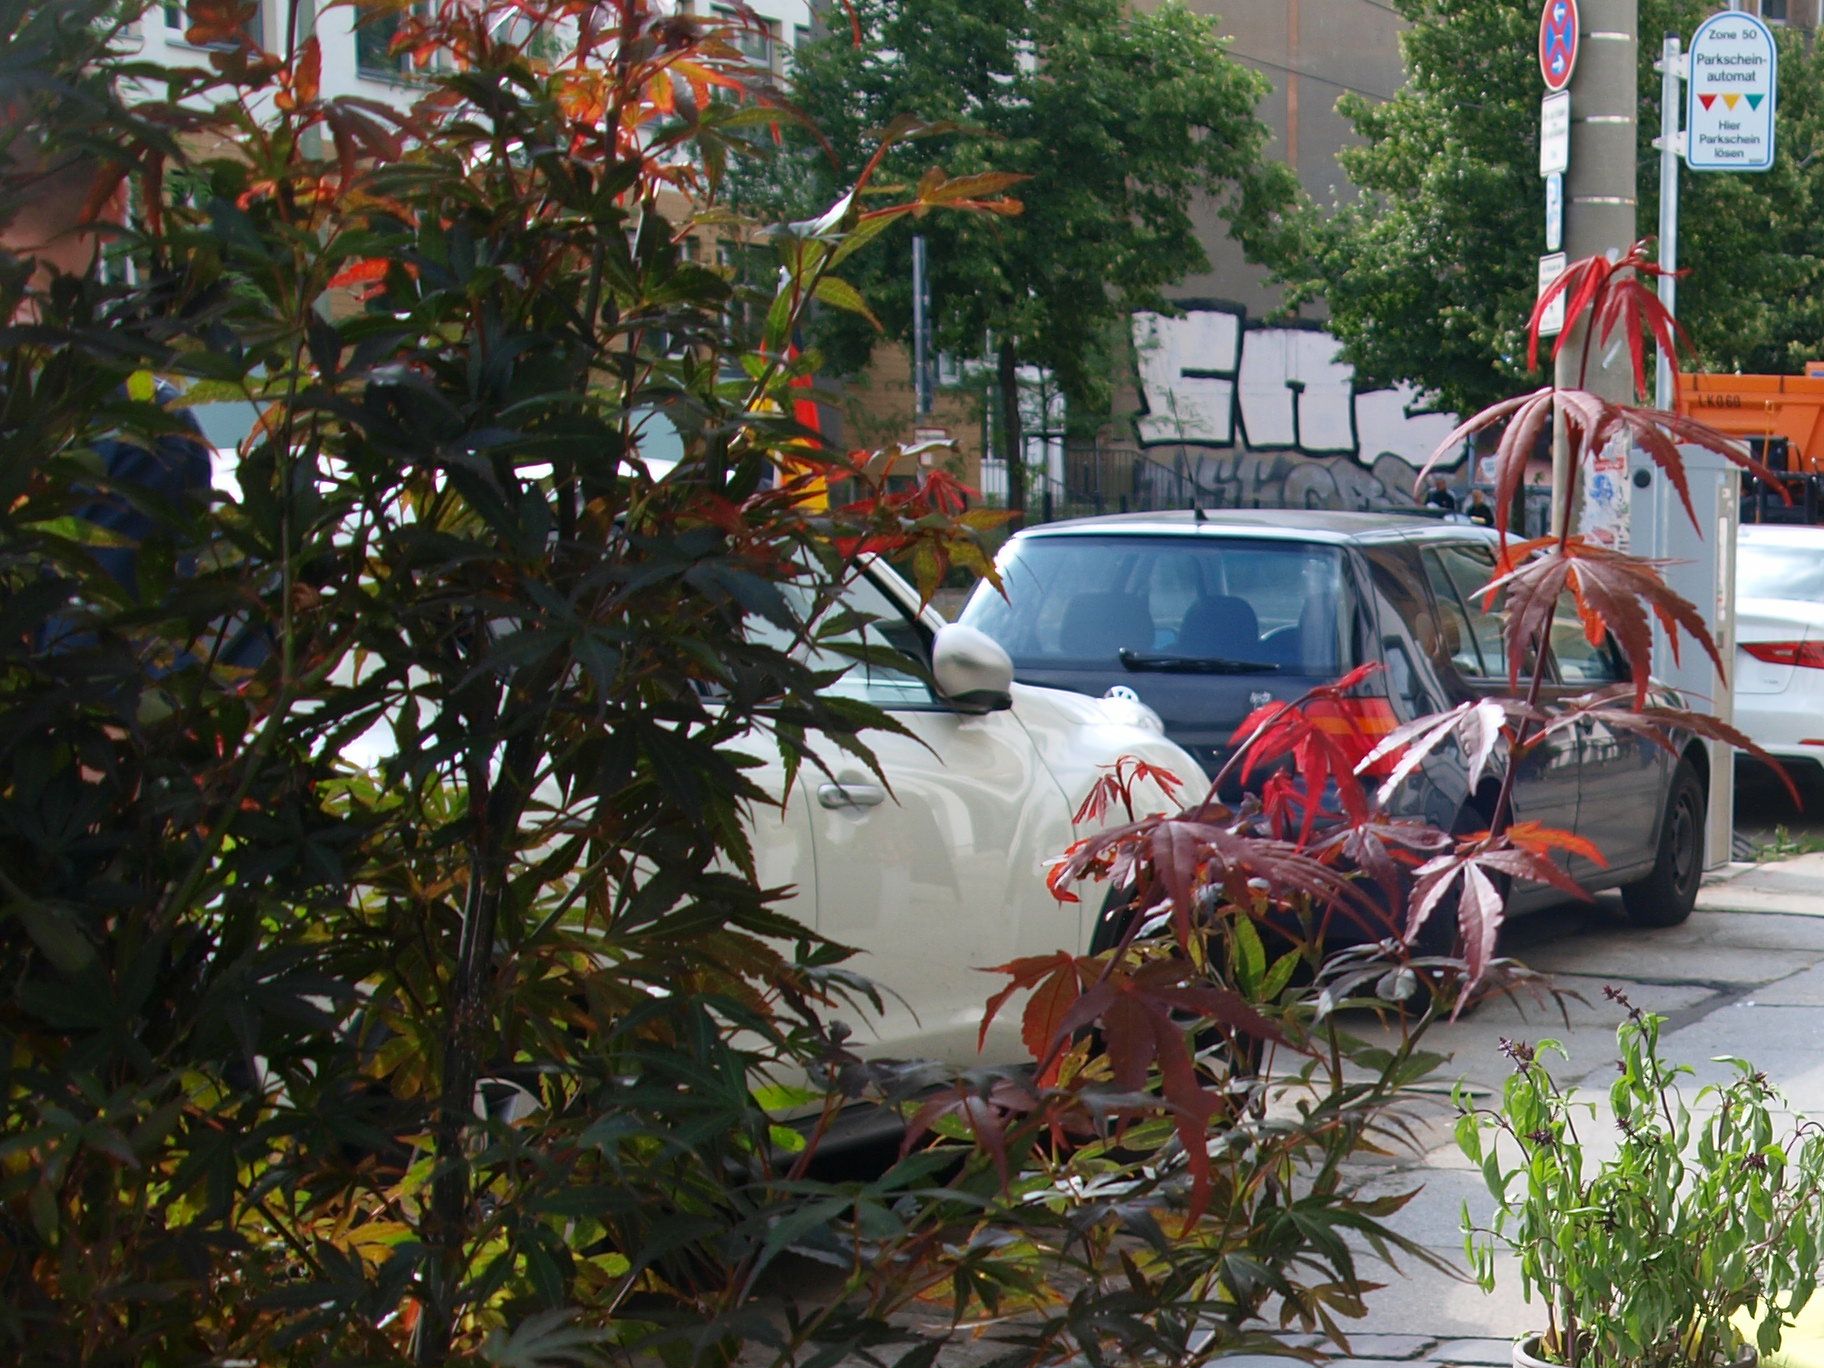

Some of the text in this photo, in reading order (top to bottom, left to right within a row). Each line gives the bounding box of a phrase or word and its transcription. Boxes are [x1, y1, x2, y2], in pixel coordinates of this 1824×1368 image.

[1709, 29, 1757, 40] Zone 50
[1697, 53, 1767, 65] Parkschein-
[1707, 71, 1756, 82] automat
[1718, 119, 1741, 130] Hier
[1699, 134, 1760, 144] Parkschein
[1714, 147, 1744, 158] lösen
